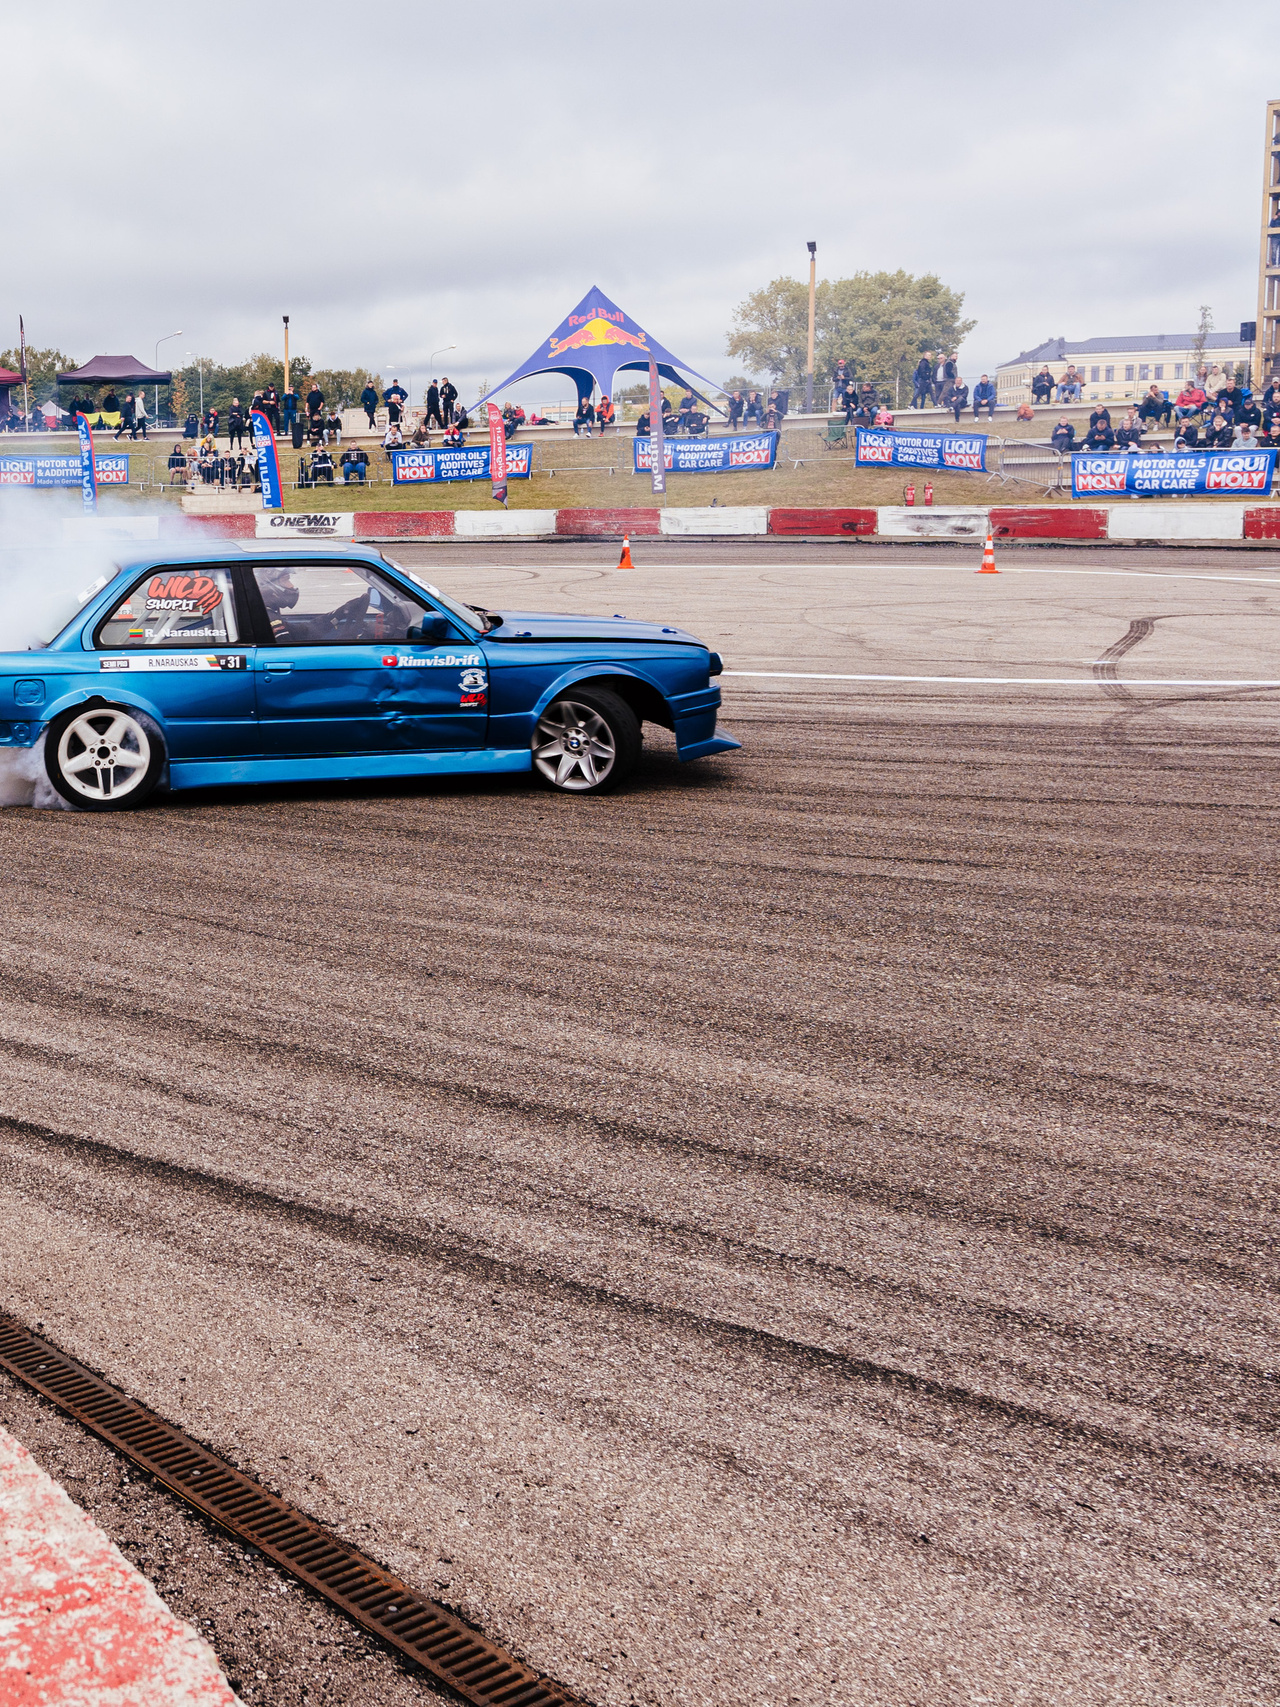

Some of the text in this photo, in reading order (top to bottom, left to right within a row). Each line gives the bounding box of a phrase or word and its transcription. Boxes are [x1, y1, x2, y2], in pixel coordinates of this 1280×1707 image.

[568, 307, 624, 327] Red Bull
[731, 438, 770, 453] LIQUI
[861, 433, 892, 448] LIQUI
[895, 437, 942, 448] MOTOR OILS
[638, 444, 671, 456] LII
[676, 442, 728, 452] MOTOR OILS
[898, 446, 939, 458] ADDITIVES
[944, 440, 981, 454] LIQUI
[437, 451, 488, 462] MOTOR OILS
[506, 450, 527, 461] QUI
[678, 451, 724, 460] ADDITIVES
[730, 451, 769, 465] MOLY
[860, 447, 893, 461] MOLY
[897, 454, 939, 465] CAR CARE
[0, 462, 33, 472] LIQUI
[37, 460, 67, 468] MOTOR
[398, 455, 432, 467] LIQUI
[440, 460, 485, 470] ADDITIVES
[506, 460, 527, 473] OLY
[637, 455, 671, 468] MY
[679, 459, 723, 468] CAR CARE
[944, 454, 982, 469] MOLY
[1078, 459, 1127, 474] LIQUI
[1132, 458, 1207, 469] MOTOR OILS
[1211, 456, 1266, 472] LIQUI
[0, 473, 34, 483] MOLY
[37, 469, 83, 477] & ADDITIVE
[398, 467, 434, 480] MOLY
[441, 468, 484, 478] CAR CARE
[1134, 469, 1200, 479] ADDITIVES
[1077, 475, 1125, 490] MOLY
[1135, 478, 1196, 490] CAR CARE
[1209, 471, 1265, 488] MOLY
[147, 576, 214, 600] WILD
[145, 599, 198, 611] SHOP.LT
[145, 627, 227, 637] R. Narauskas
[148, 657, 199, 668] R.NARAUSKAS
[227, 656, 241, 668] 31
[398, 654, 480, 667] RimvisDrift
[460, 693, 485, 703] WILD
